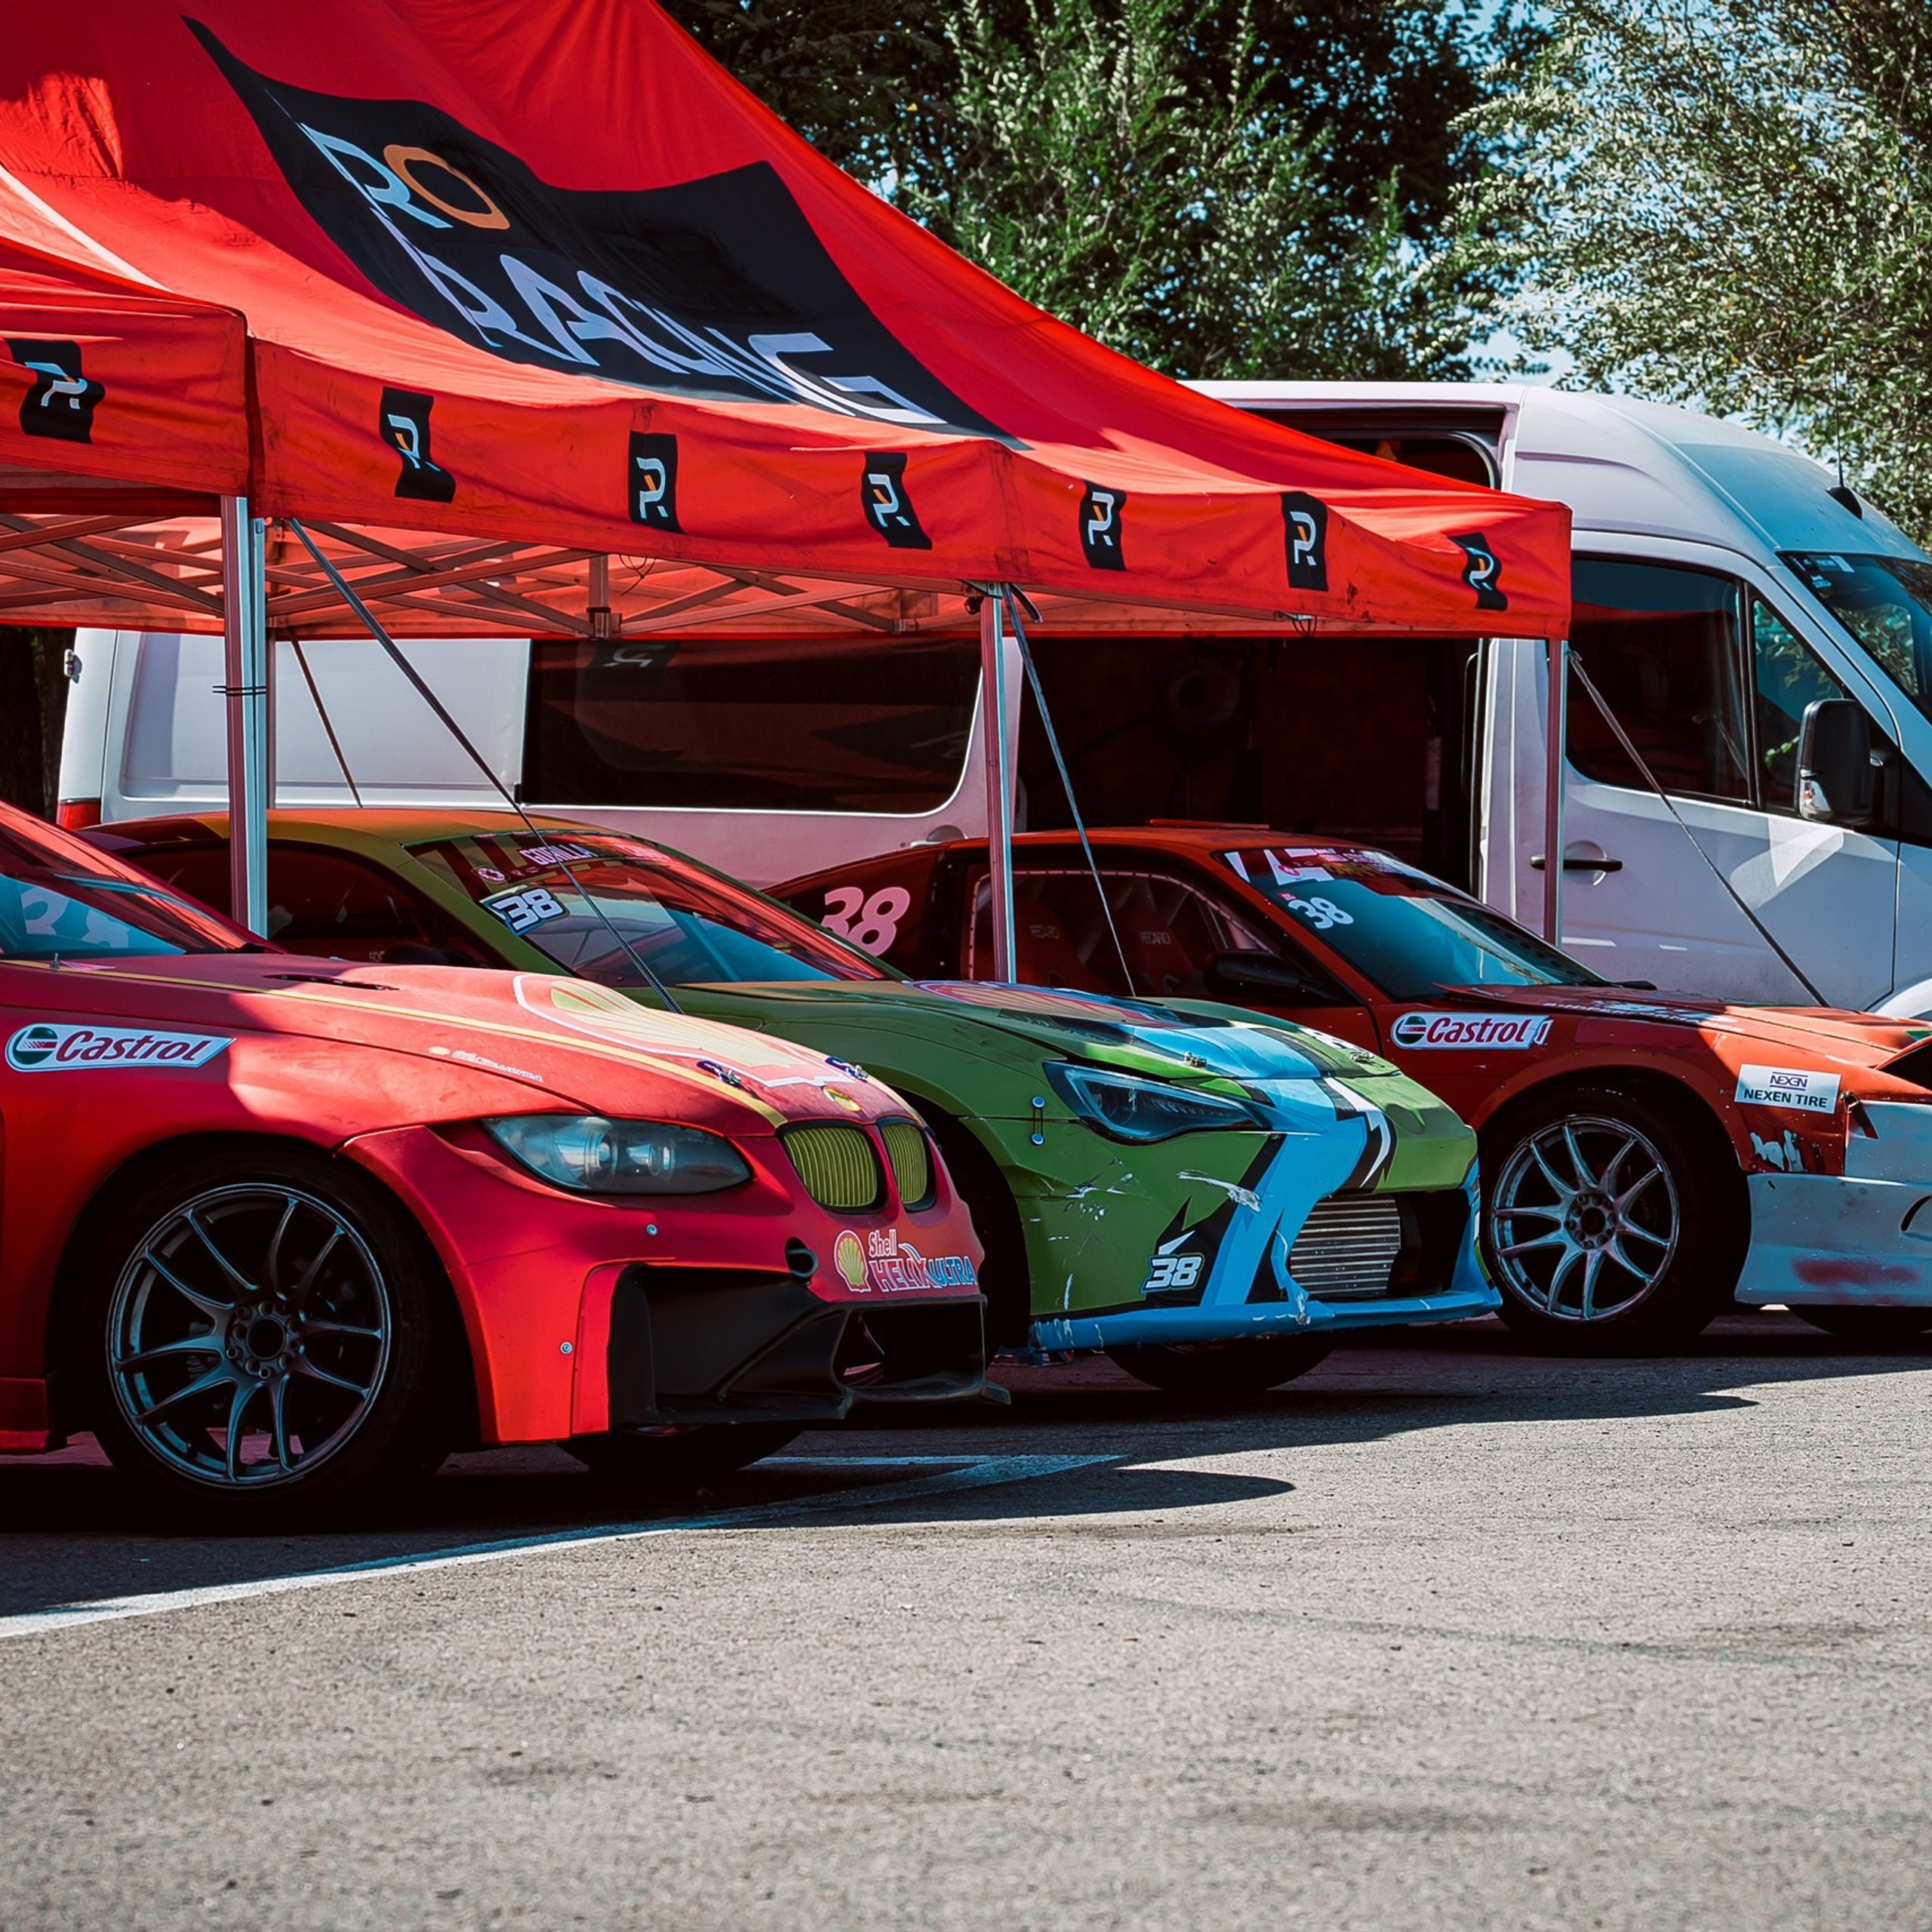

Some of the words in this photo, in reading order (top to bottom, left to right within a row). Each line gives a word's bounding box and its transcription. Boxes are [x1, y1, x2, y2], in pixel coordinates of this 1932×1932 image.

[518, 844, 598, 866] GORILLA
[491, 888, 564, 931] 38
[821, 886, 911, 957] 38
[1287, 897, 1354, 929] 38
[1139, 931, 1171, 945] RECARO
[1426, 1017, 1532, 1043] Castrol
[55, 1031, 212, 1062] Castrol
[1770, 1075, 1808, 1088] NEXEN
[1743, 1088, 1792, 1103] NEXEN
[1795, 1094, 1829, 1108] TIRE
[868, 1229, 898, 1258] Shell
[869, 1257, 931, 1292] HELIX
[924, 1257, 978, 1288] ULTRA
[1145, 1256, 1202, 1288] 38
